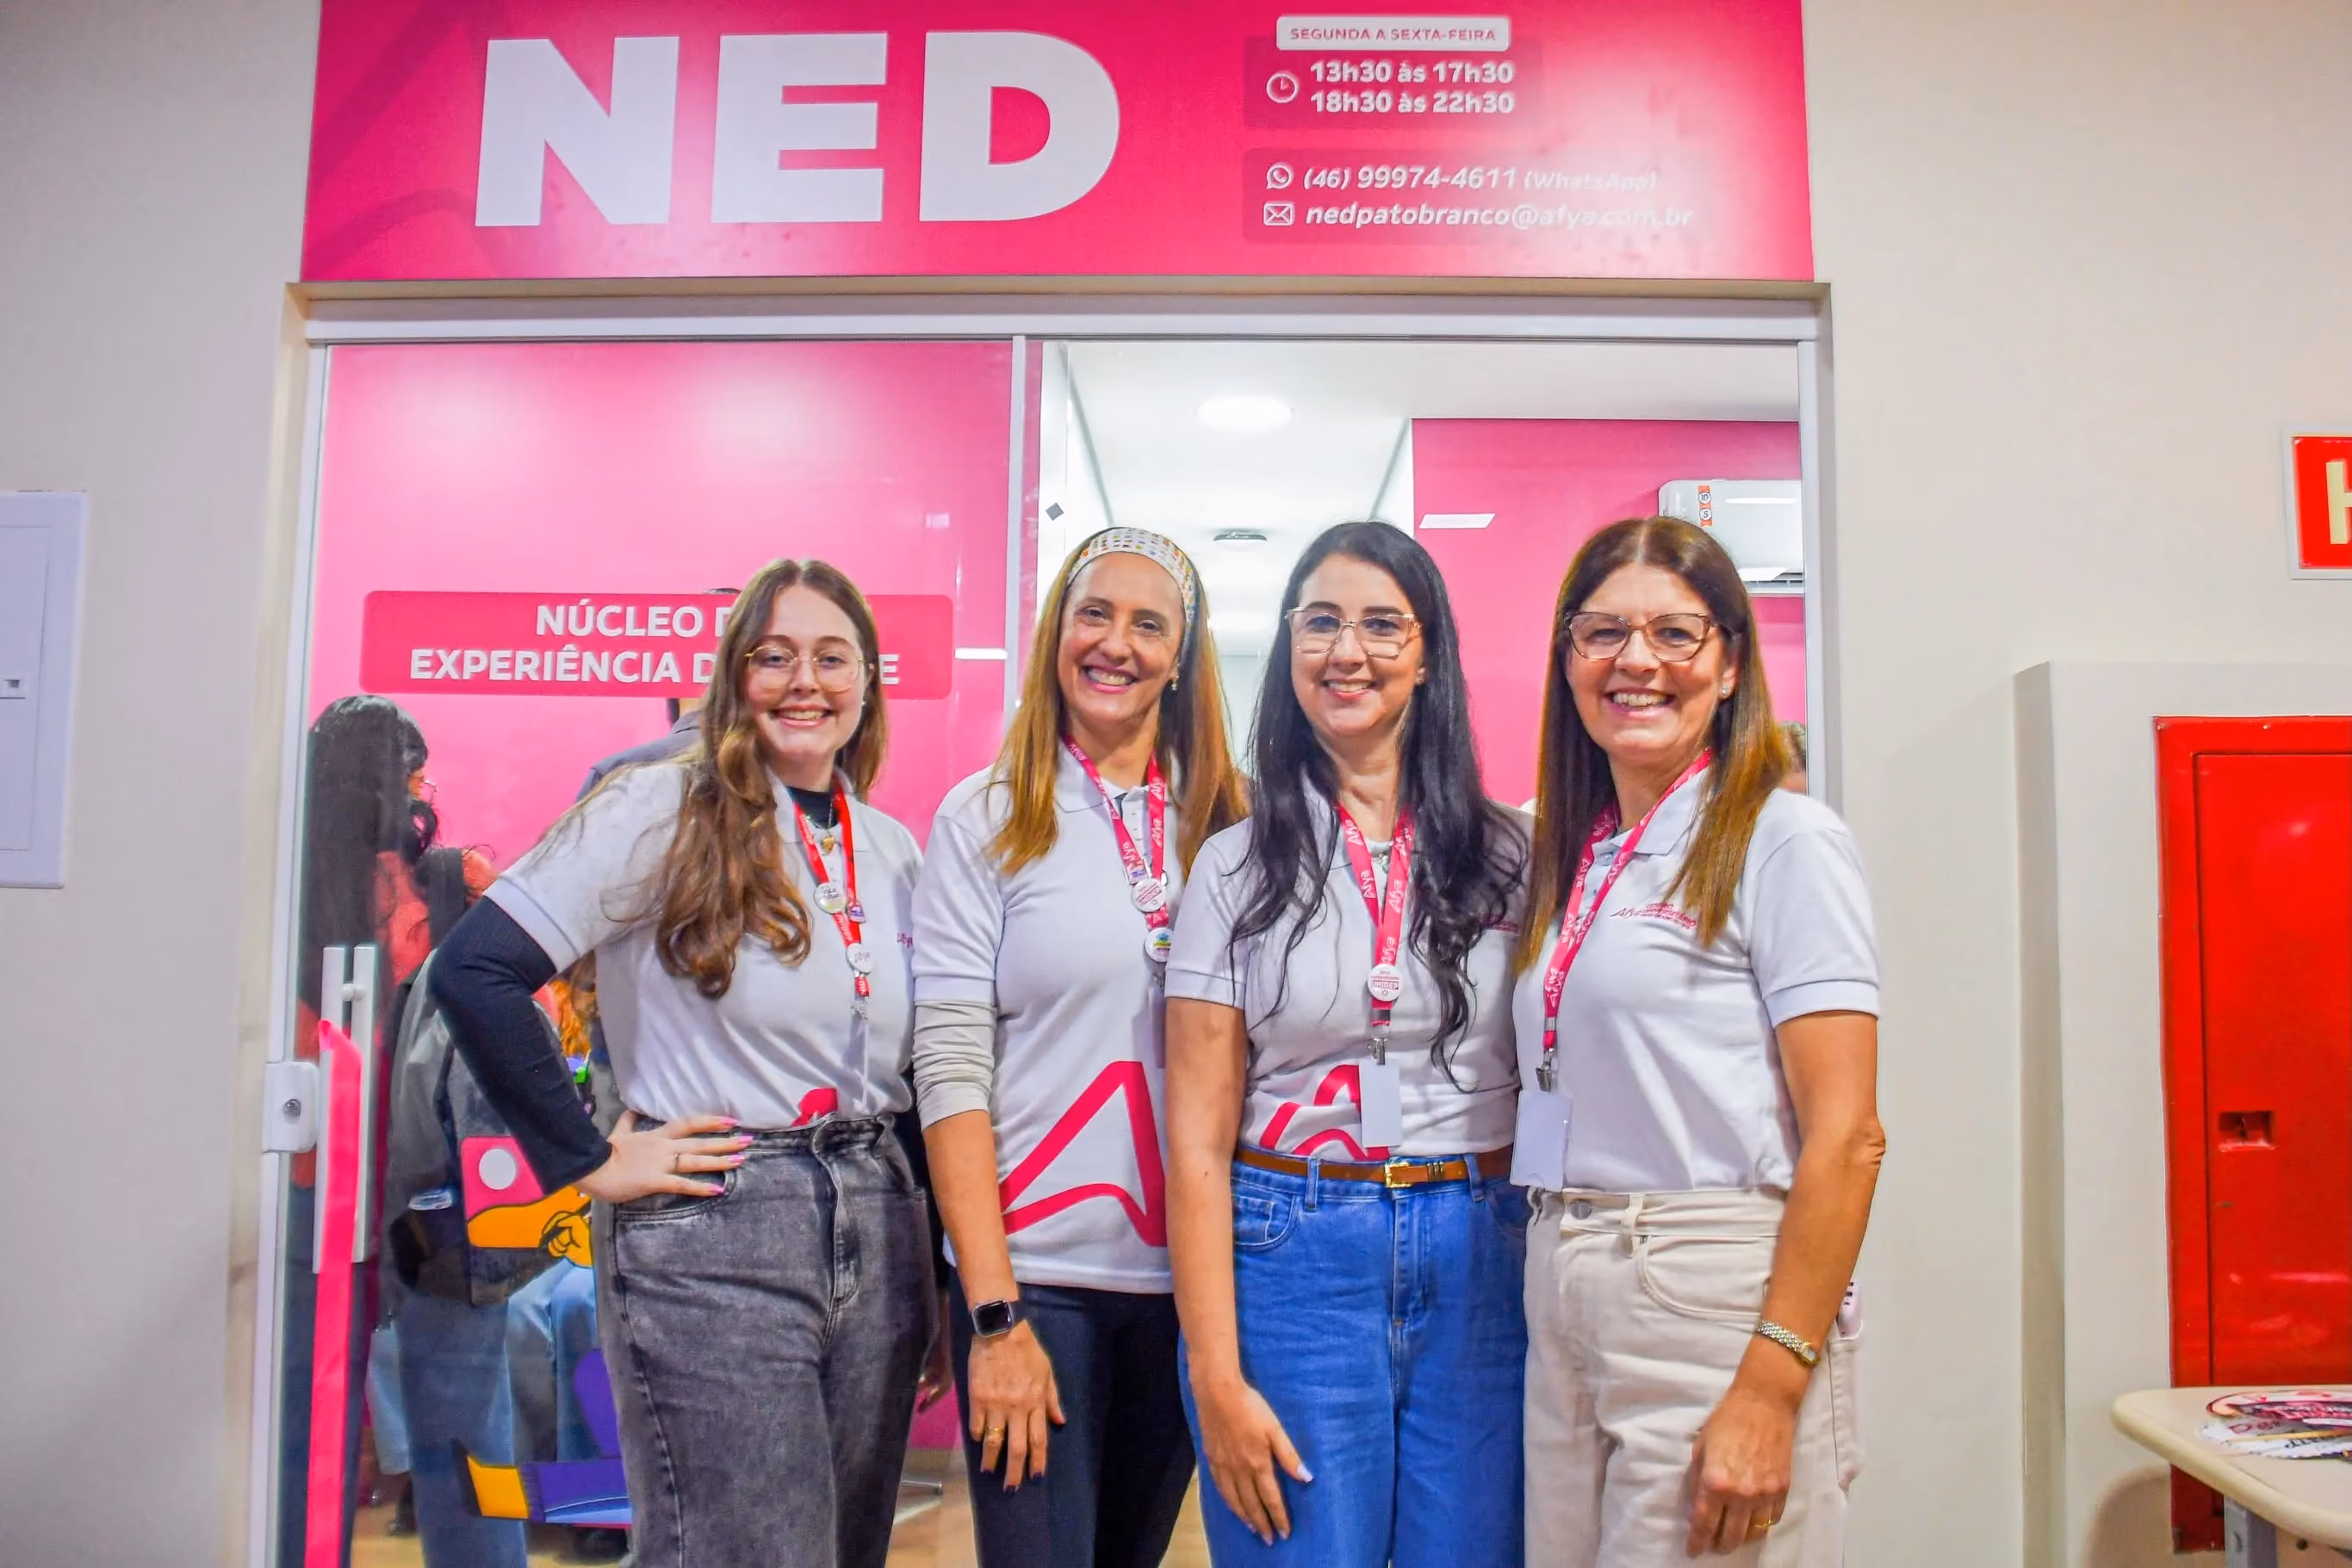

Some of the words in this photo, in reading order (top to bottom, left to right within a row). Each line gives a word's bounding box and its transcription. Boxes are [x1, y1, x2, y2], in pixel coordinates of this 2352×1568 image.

[1290, 28, 1371, 40] SEGUNDA
[1375, 28, 1386, 40] A
[1391, 28, 1497, 41] SEXTA-FEIRA
[1310, 61, 1393, 84] 13h30
[1397, 62, 1427, 84] às
[1432, 62, 1514, 84] 17h30
[1310, 91, 1393, 113] 18h30
[1397, 93, 1427, 113] às
[1432, 92, 1515, 114] 22h30
[475, 31, 1120, 226] NED
[1303, 168, 1350, 190] (46)
[1357, 165, 1517, 189] 99974-4611
[1524, 170, 1658, 191] (WhatsApp)
[1305, 202, 1694, 230] nedpatobranco@afya.com.br
[1700, 493, 1710, 502] 10
[536, 598, 704, 637] NÚCLEO
[409, 644, 682, 683] EXPERIÊNCIA
[1387, 879, 1405, 914] Afya
